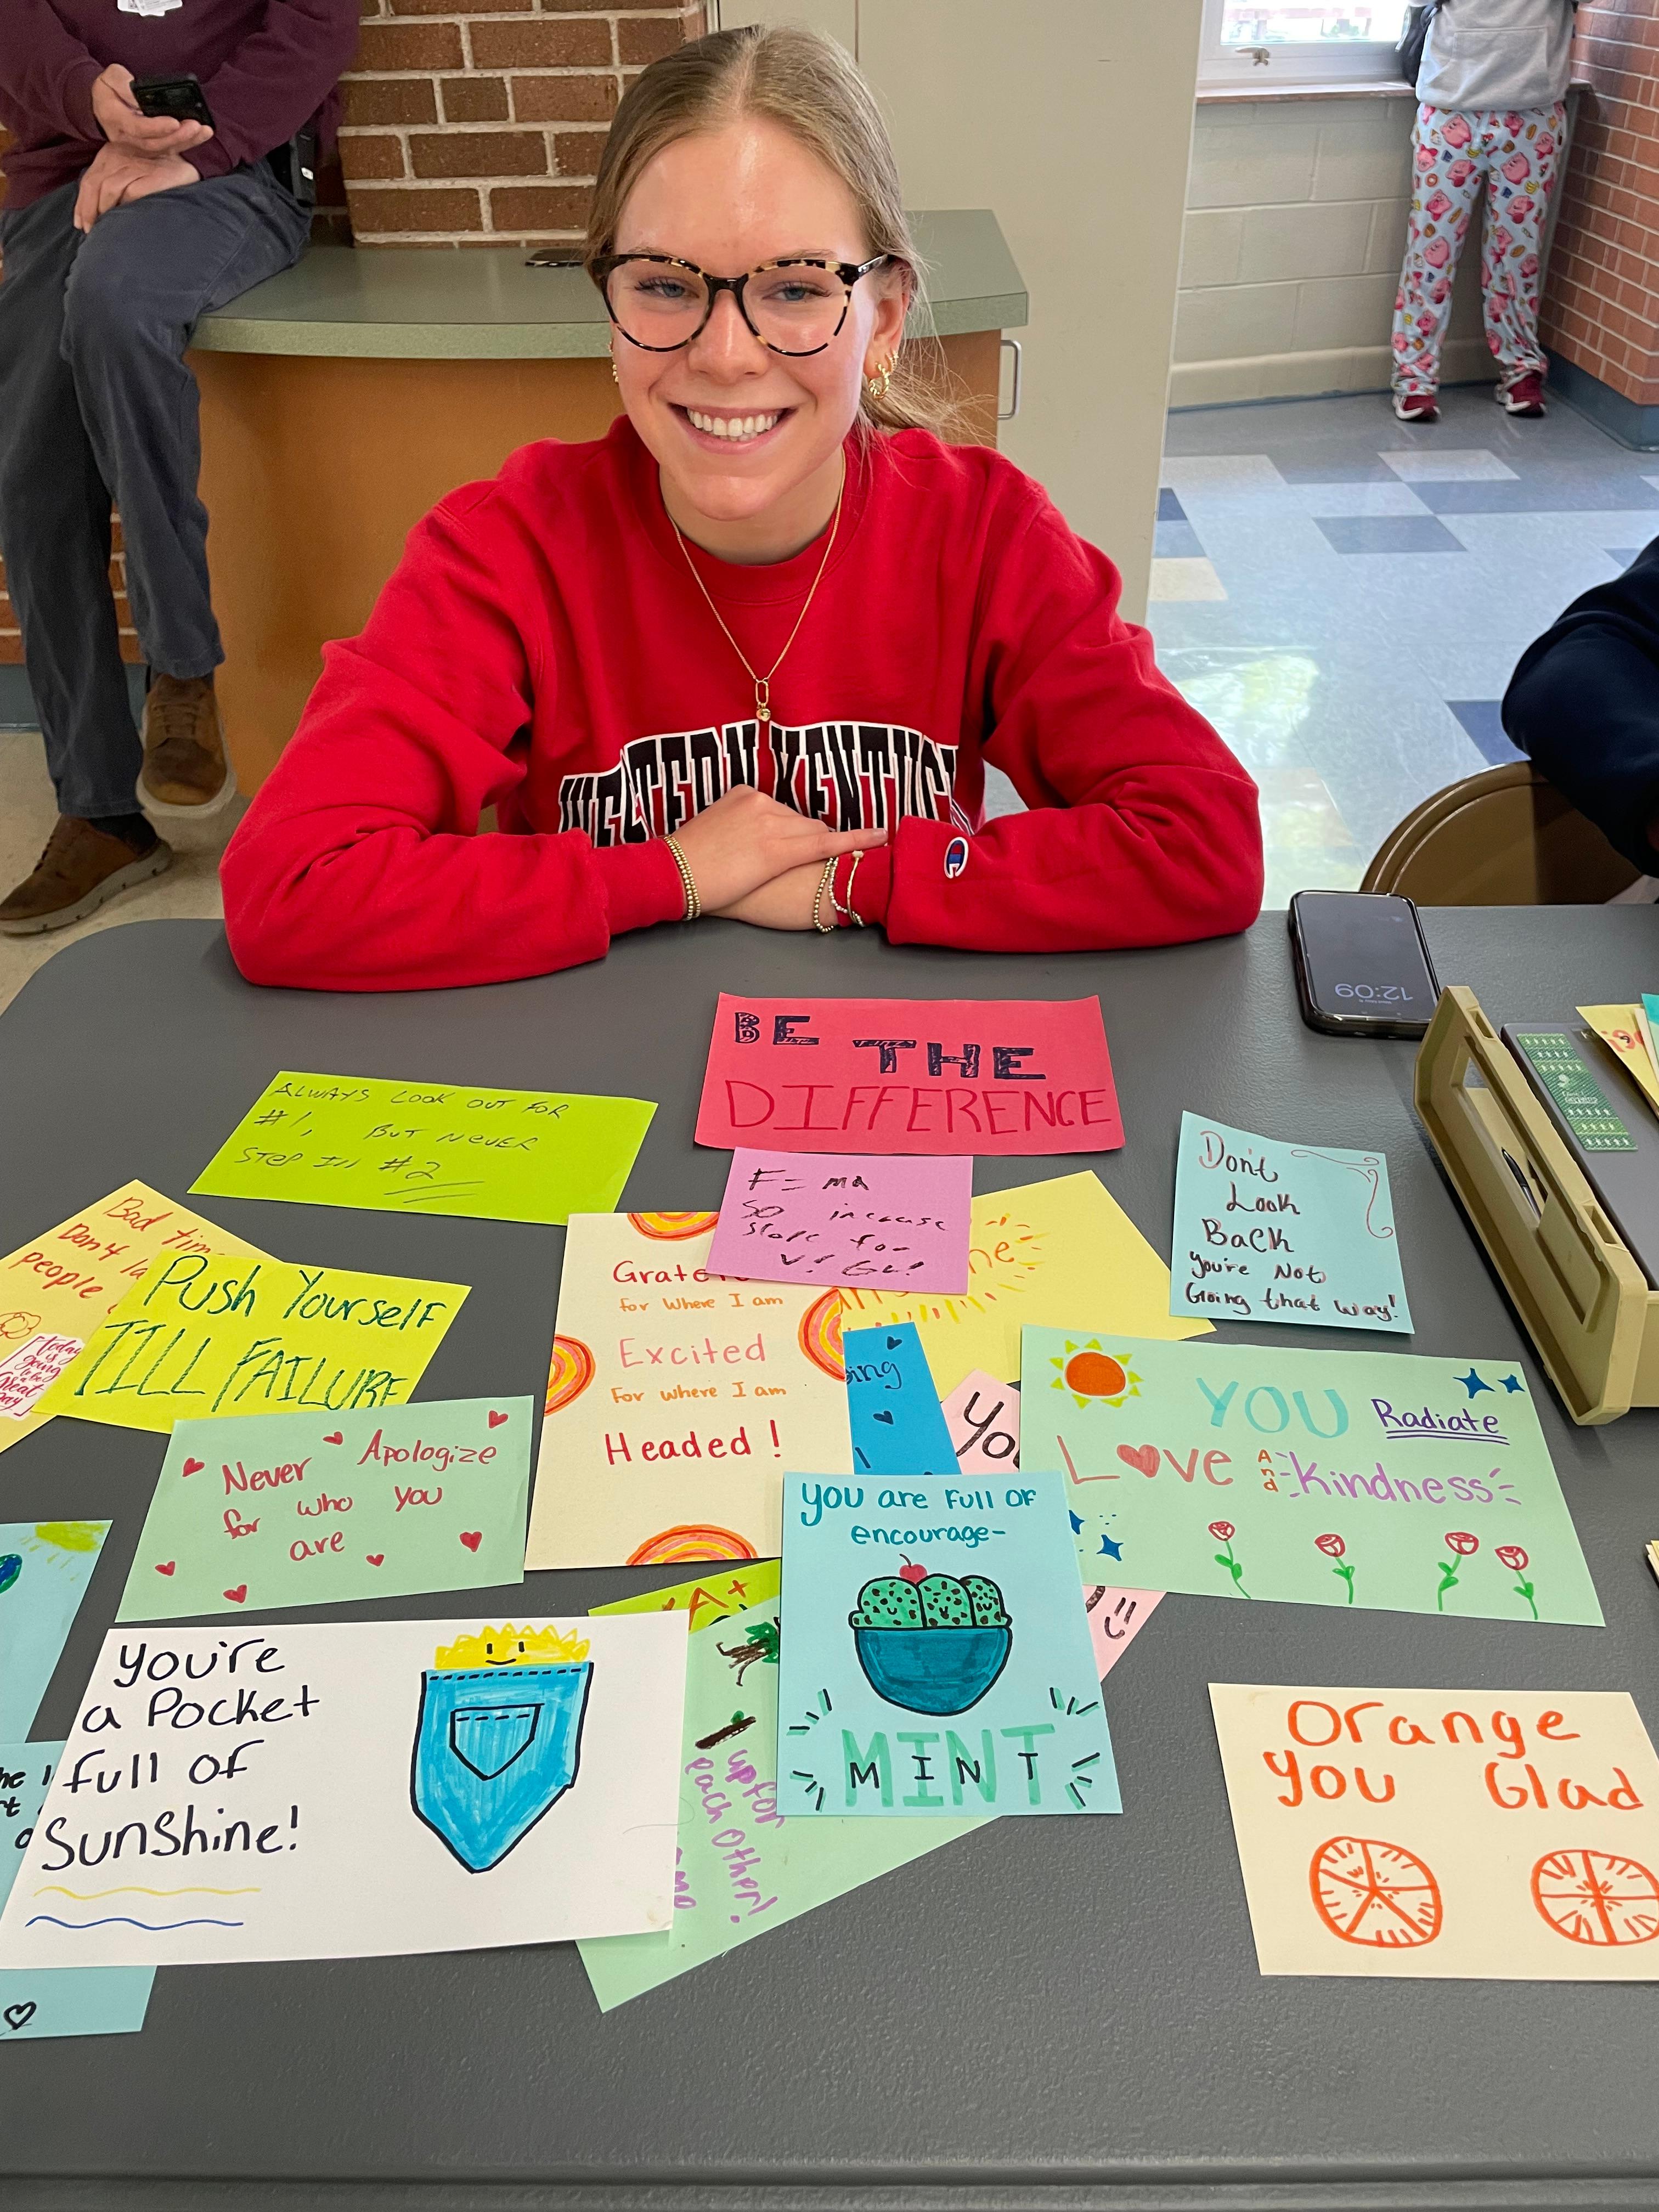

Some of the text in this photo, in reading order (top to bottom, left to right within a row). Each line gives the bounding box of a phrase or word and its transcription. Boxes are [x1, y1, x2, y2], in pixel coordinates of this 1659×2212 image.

[1335, 983, 1413, 1001] 12:09
[734, 1011, 820, 1046] BE
[851, 1038, 1047, 1081] THE
[725, 1080, 1111, 1135] DIFFERENCE
[1198, 1129, 1280, 1183] Don't
[101, 1195, 225, 1255] Bad tim
[8, 1252, 104, 1299] people
[143, 1255, 262, 1317] Push
[613, 1261, 751, 1284] Grate
[1273, 1261, 1327, 1284] Not
[728, 1293, 744, 1307] I
[752, 1297, 783, 1306] am
[1185, 1281, 1251, 1316] Going
[1259, 1288, 1321, 1312] that
[74, 1319, 206, 1396] TILL
[619, 1333, 765, 1368] Excited
[731, 1381, 747, 1398] I
[754, 1386, 787, 1397] am
[1196, 1377, 1498, 1439] YOU Radiate
[221, 1426, 497, 1496] Never Apologize
[223, 1486, 443, 1540] for who you
[878, 1489, 929, 1509] are
[289, 1531, 345, 1561] are
[81, 1705, 122, 1733] a
[1284, 1700, 1581, 1761] Orange
[62, 1748, 158, 1793] full
[188, 1739, 265, 1785] of
[839, 1720, 1057, 1809] MINT
[1484, 1762, 1644, 1811] Glad
